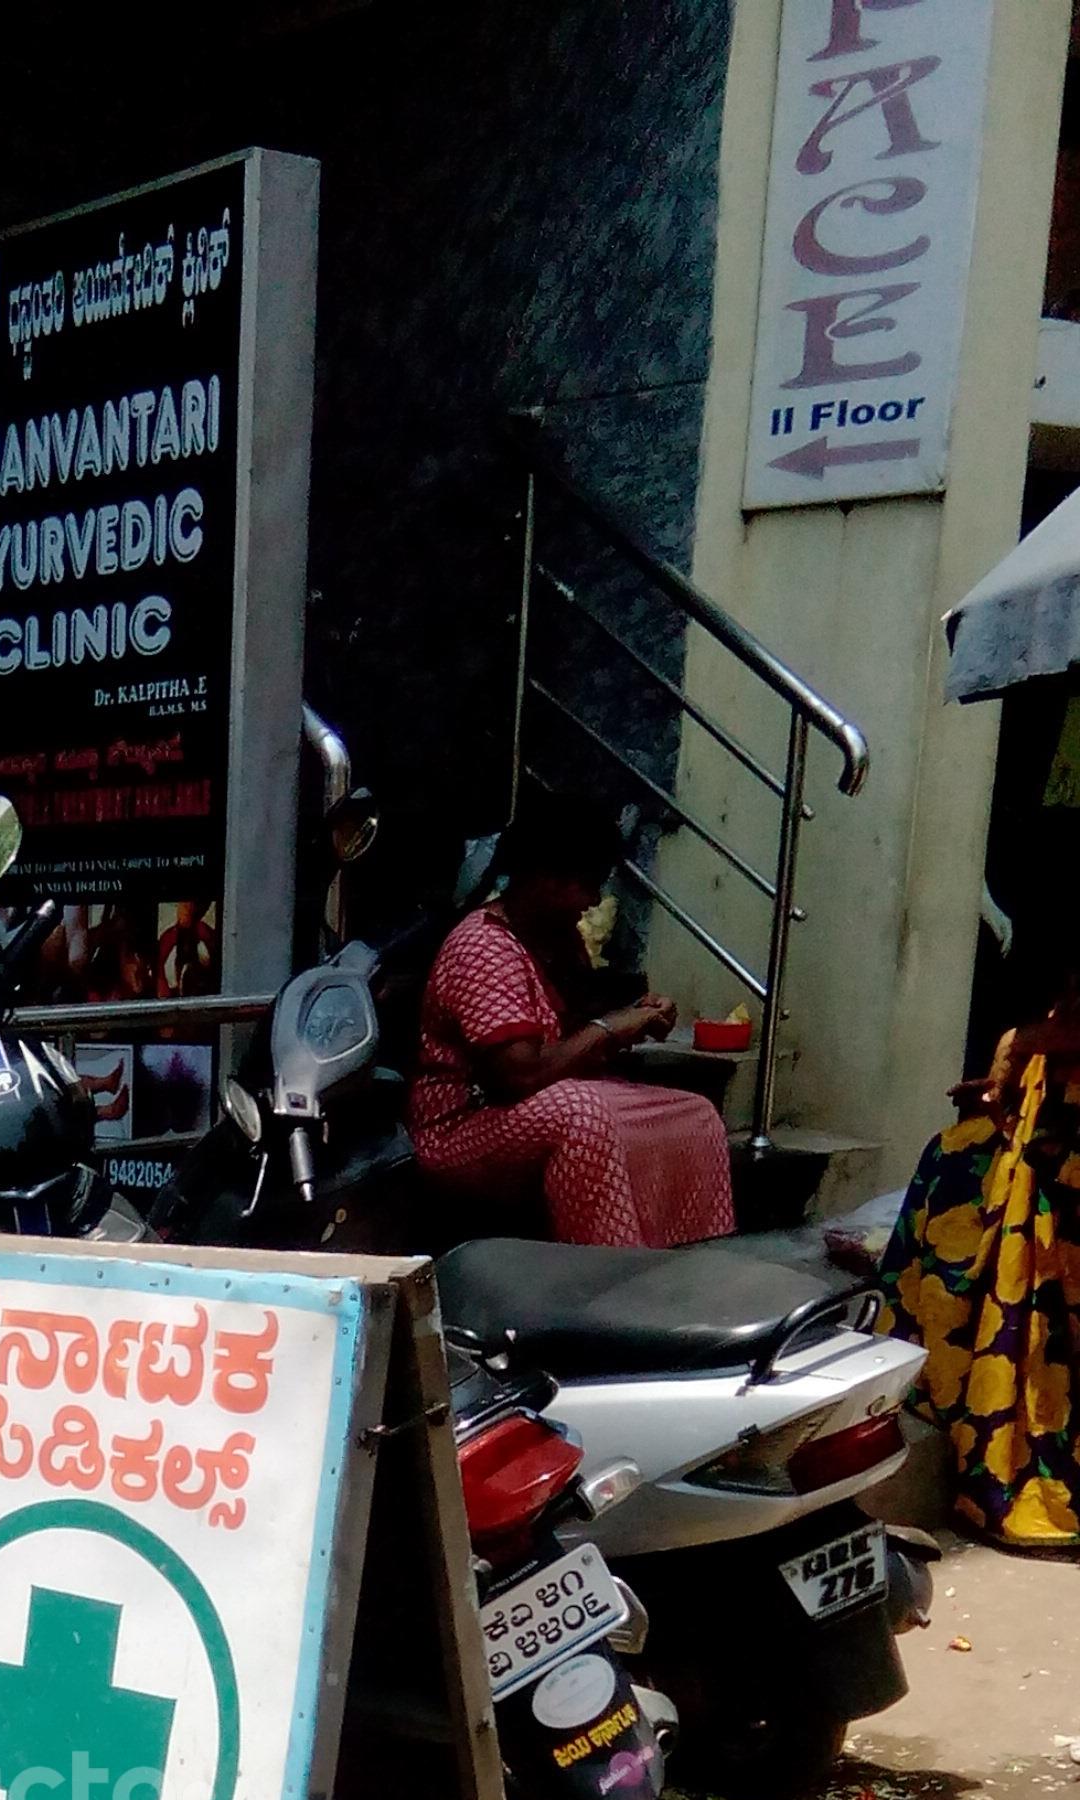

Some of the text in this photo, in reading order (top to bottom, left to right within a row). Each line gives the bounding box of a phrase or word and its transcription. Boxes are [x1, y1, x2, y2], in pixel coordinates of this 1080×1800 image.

[810, 395, 925, 431] Floor
[94, 688, 114, 707] Dr.
[118, 679, 190, 704] KALPITHA
